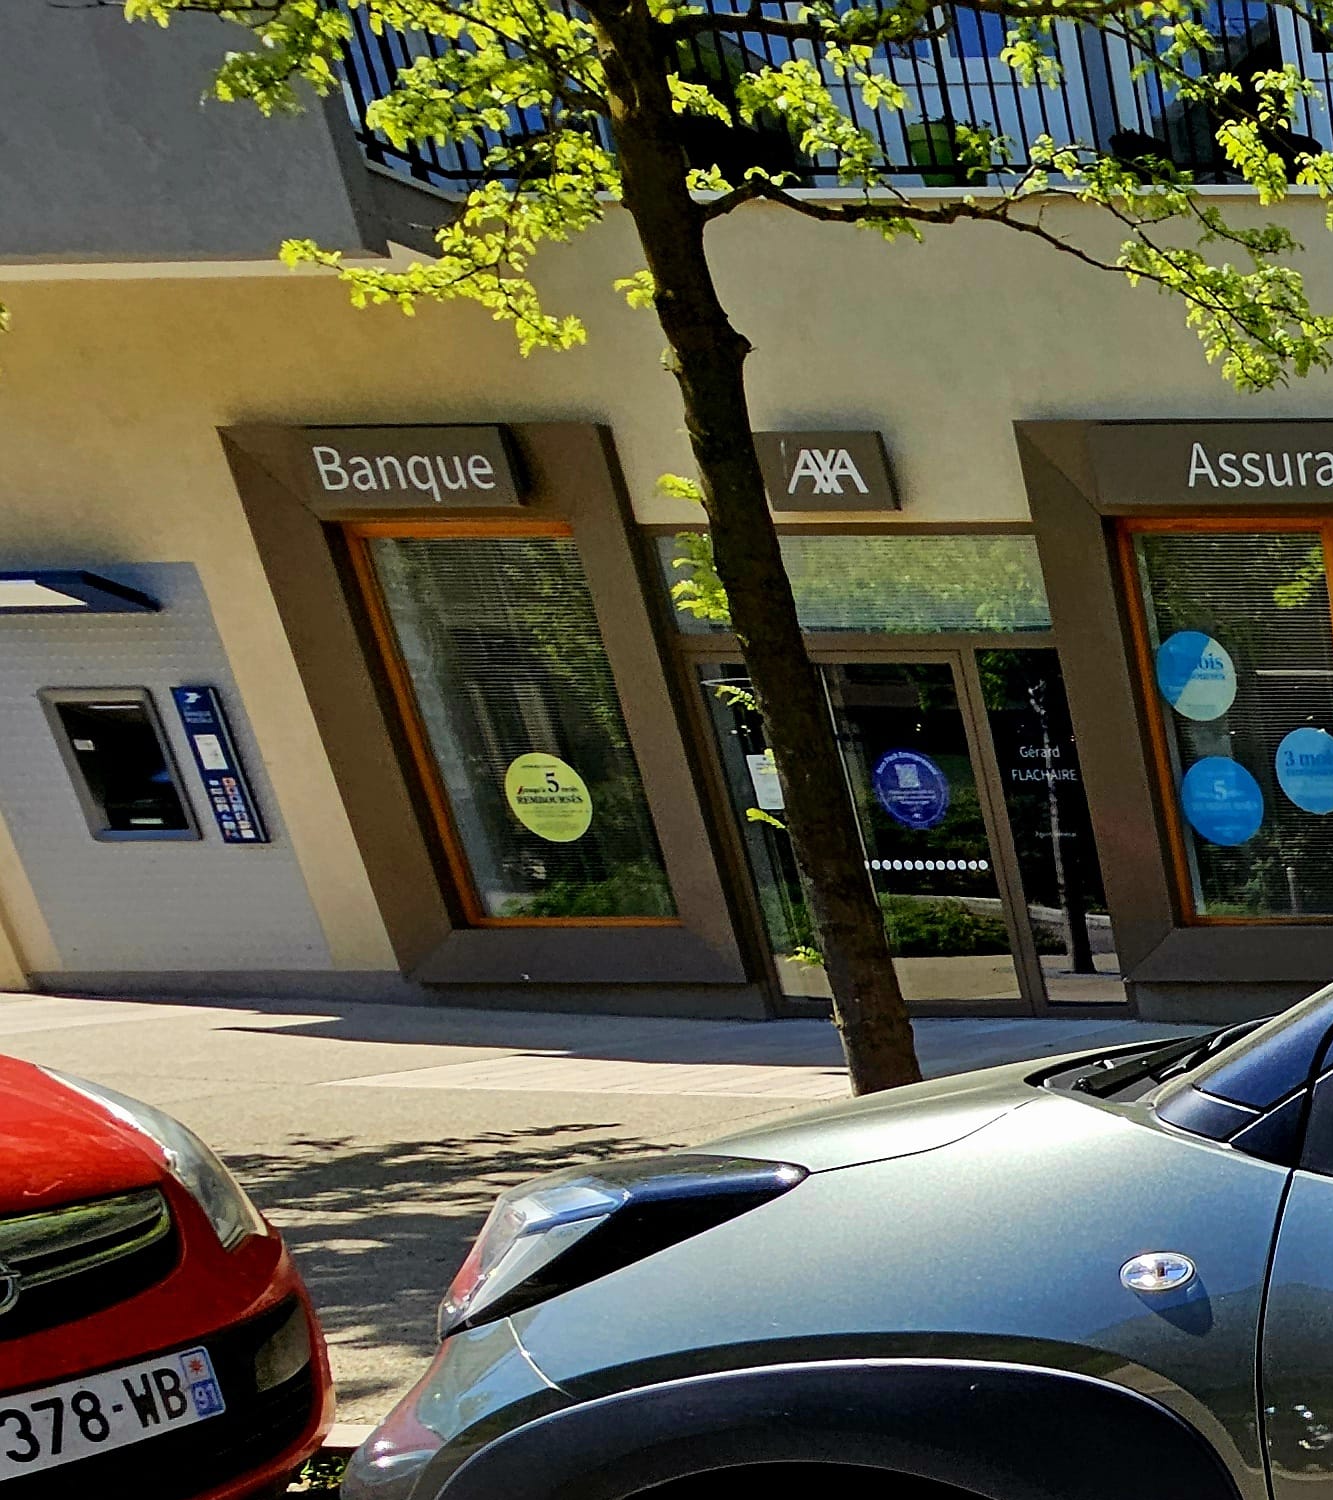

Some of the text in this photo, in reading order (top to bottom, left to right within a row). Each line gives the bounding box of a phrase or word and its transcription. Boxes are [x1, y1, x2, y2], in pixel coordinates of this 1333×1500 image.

[312, 446, 496, 502] Banque
[788, 448, 869, 494] AXA
[1019, 745, 1060, 758] Gérard
[1284, 749, 1296, 767] 3
[545, 772, 560, 793] 5
[1011, 769, 1078, 781] FLACHAIRE
